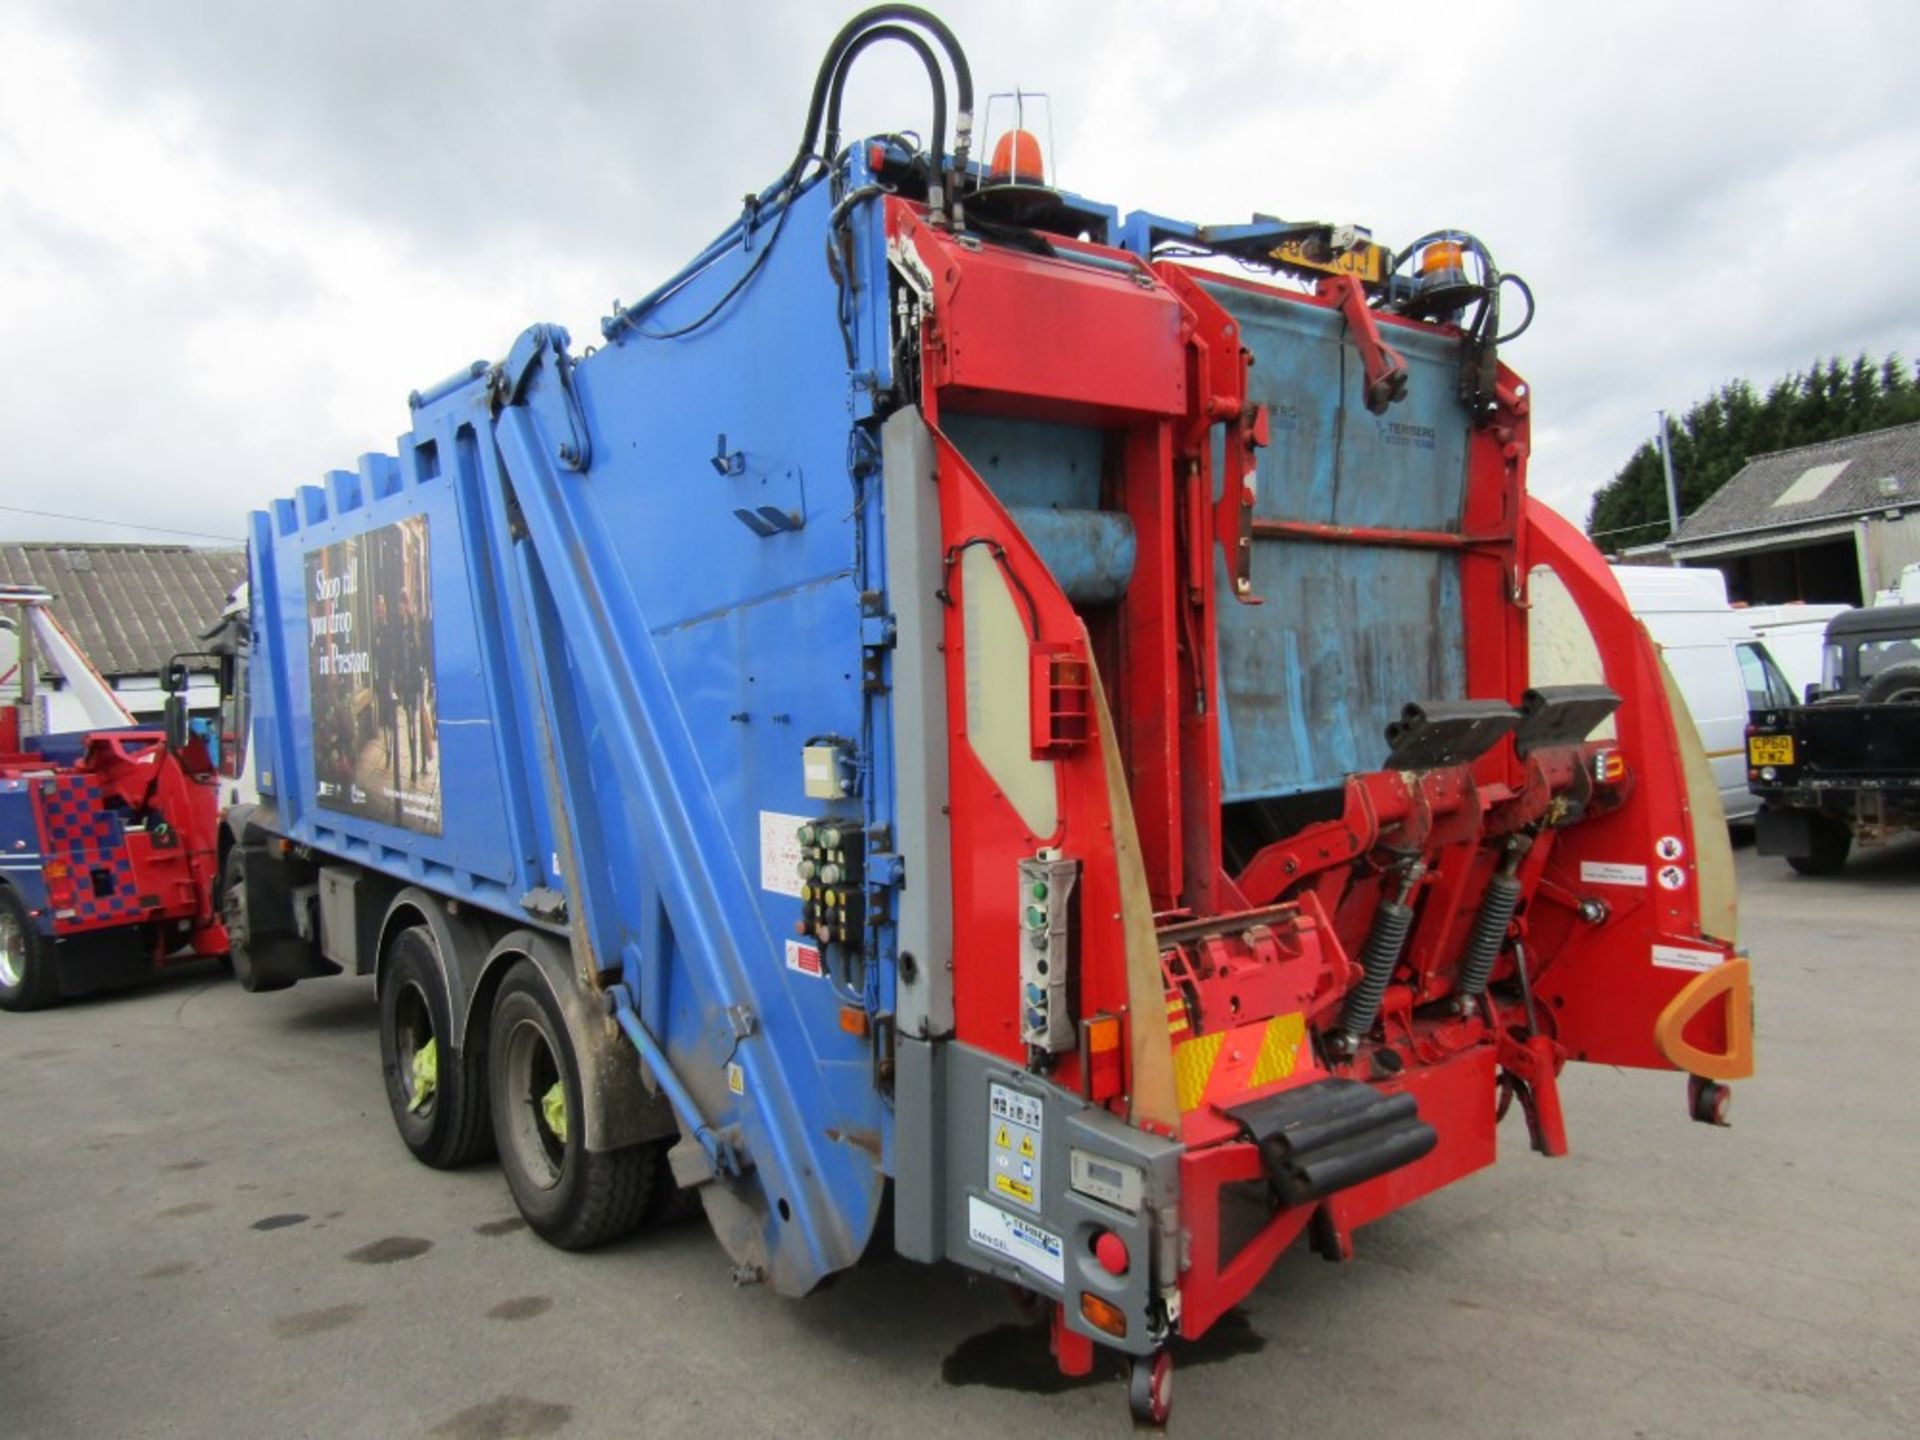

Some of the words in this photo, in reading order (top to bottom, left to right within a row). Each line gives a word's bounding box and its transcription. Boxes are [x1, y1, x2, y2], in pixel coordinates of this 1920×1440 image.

[316, 568, 341, 609] Shop
[310, 616, 327, 648] you
[328, 600, 352, 644] drop
[320, 646, 329, 674] in
[331, 643, 369, 674] Preston
